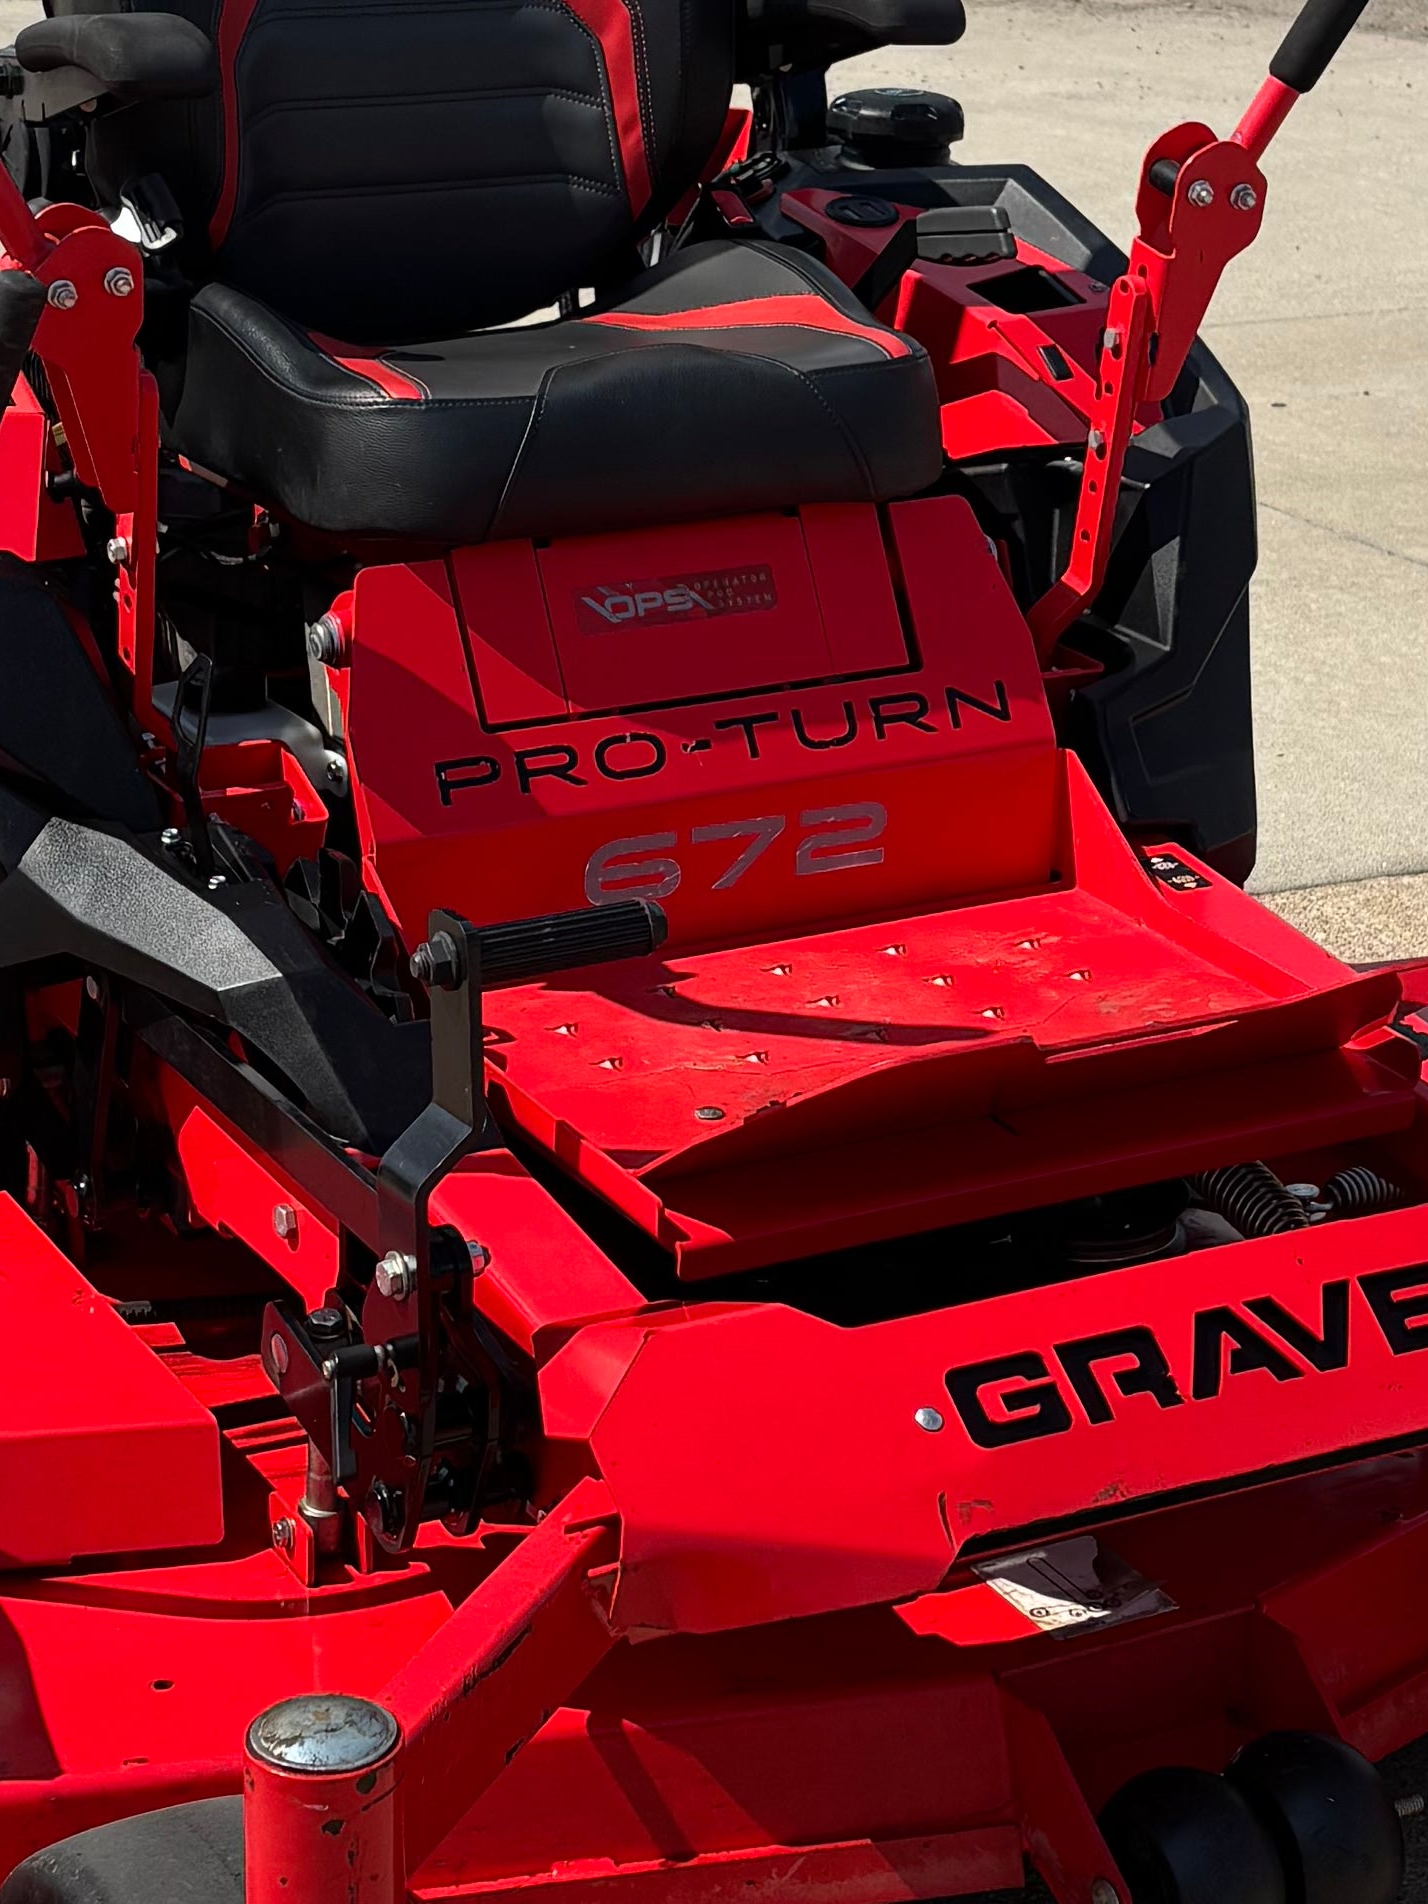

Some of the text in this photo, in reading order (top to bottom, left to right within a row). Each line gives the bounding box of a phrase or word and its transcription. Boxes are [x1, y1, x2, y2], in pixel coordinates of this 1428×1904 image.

[603, 583, 695, 619] OPS
[433, 680, 1012, 806] PRO-TURN
[584, 801, 887, 906] 672
